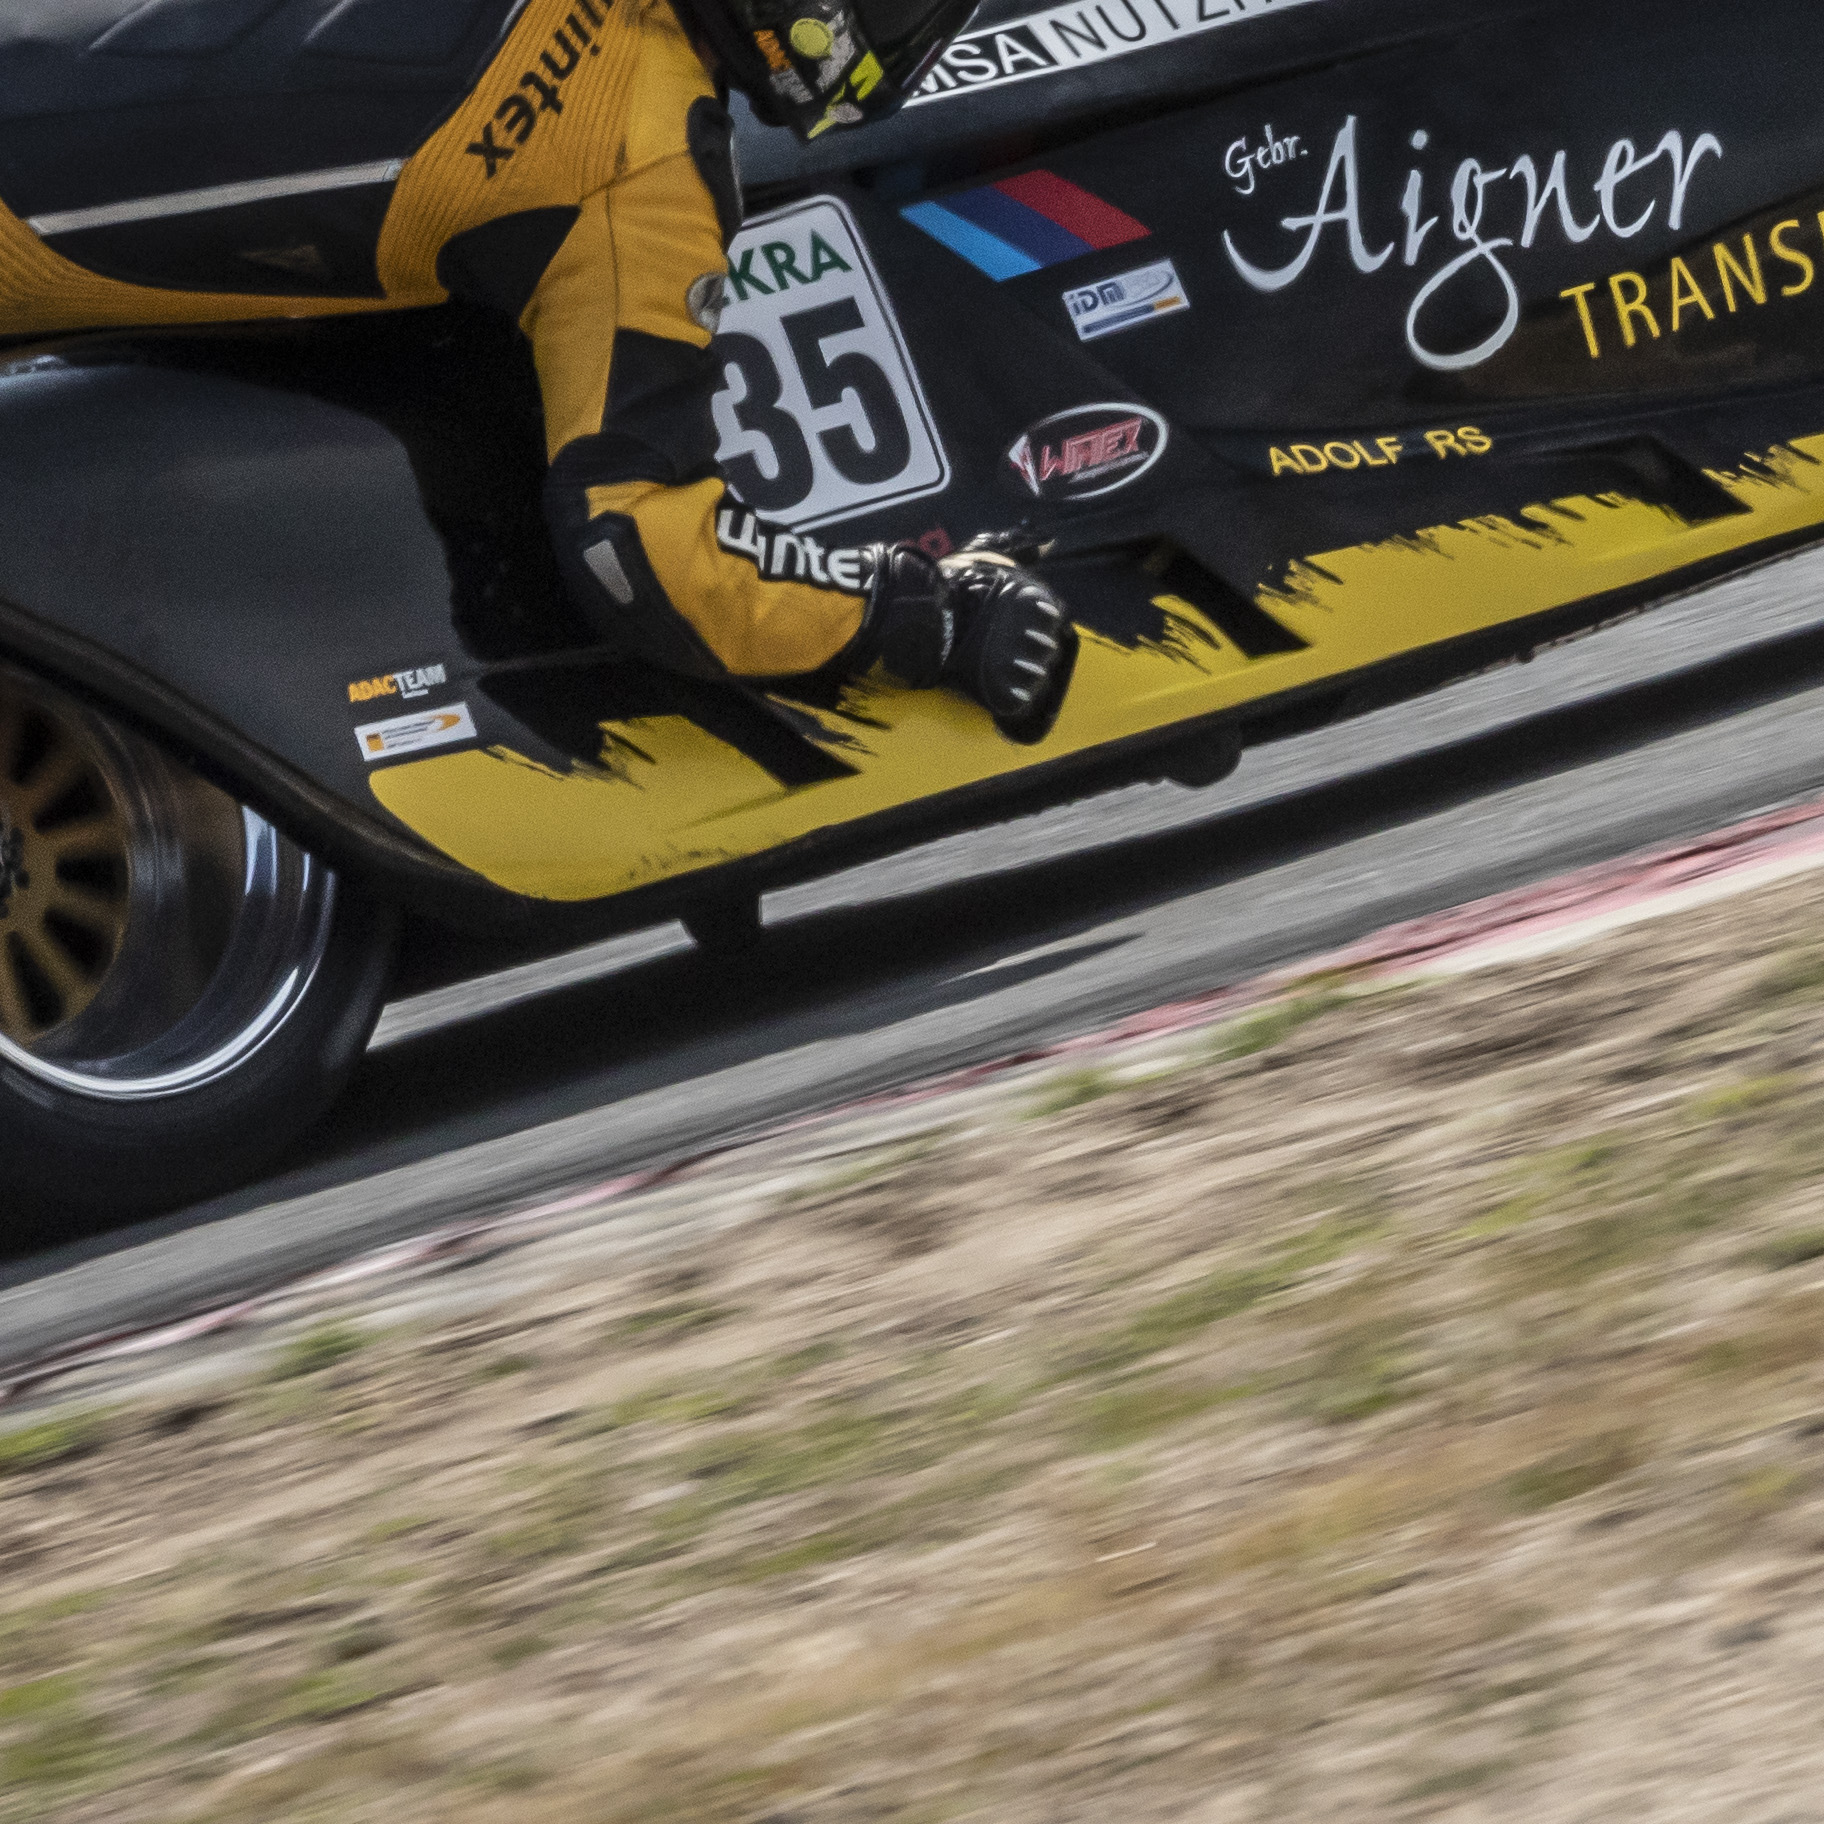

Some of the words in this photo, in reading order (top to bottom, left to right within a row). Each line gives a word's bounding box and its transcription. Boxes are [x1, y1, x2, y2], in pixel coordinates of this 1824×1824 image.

[720, 229, 853, 305] KRA
[1221, 114, 1723, 370] Aigner
[712, 295, 912, 513] 35
[1270, 437, 1404, 478] ADOLF
[1424, 426, 1493, 461] RS
[717, 507, 877, 590] winte
